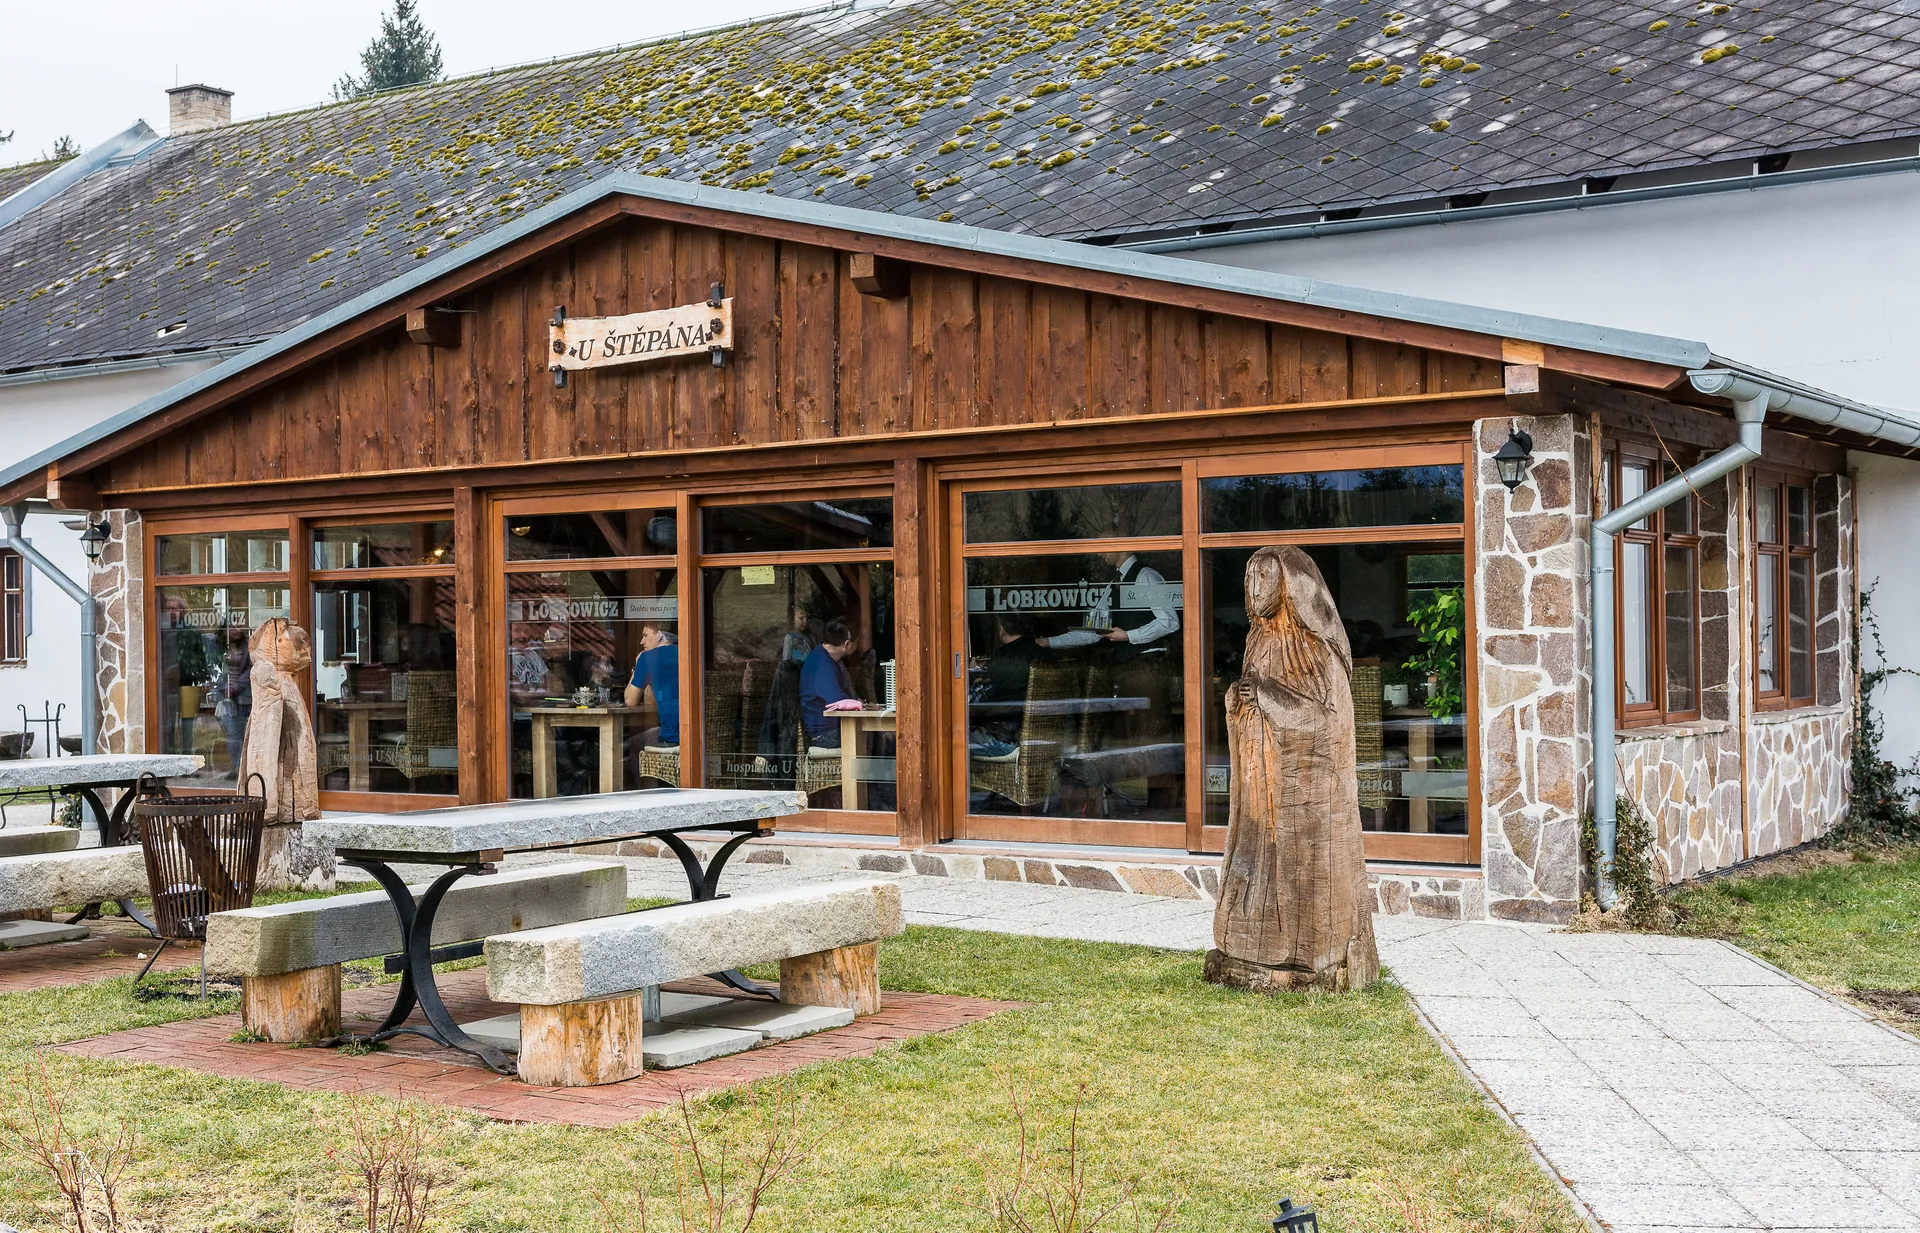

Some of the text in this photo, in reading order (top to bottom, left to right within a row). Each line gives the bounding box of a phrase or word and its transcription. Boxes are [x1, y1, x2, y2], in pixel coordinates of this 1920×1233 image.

[578, 321, 707, 361] U ŠTĚPÁNA
[993, 587, 1113, 611] LOBKOWICZ
[376, 749, 384, 763] U
[782, 760, 793, 774] U
